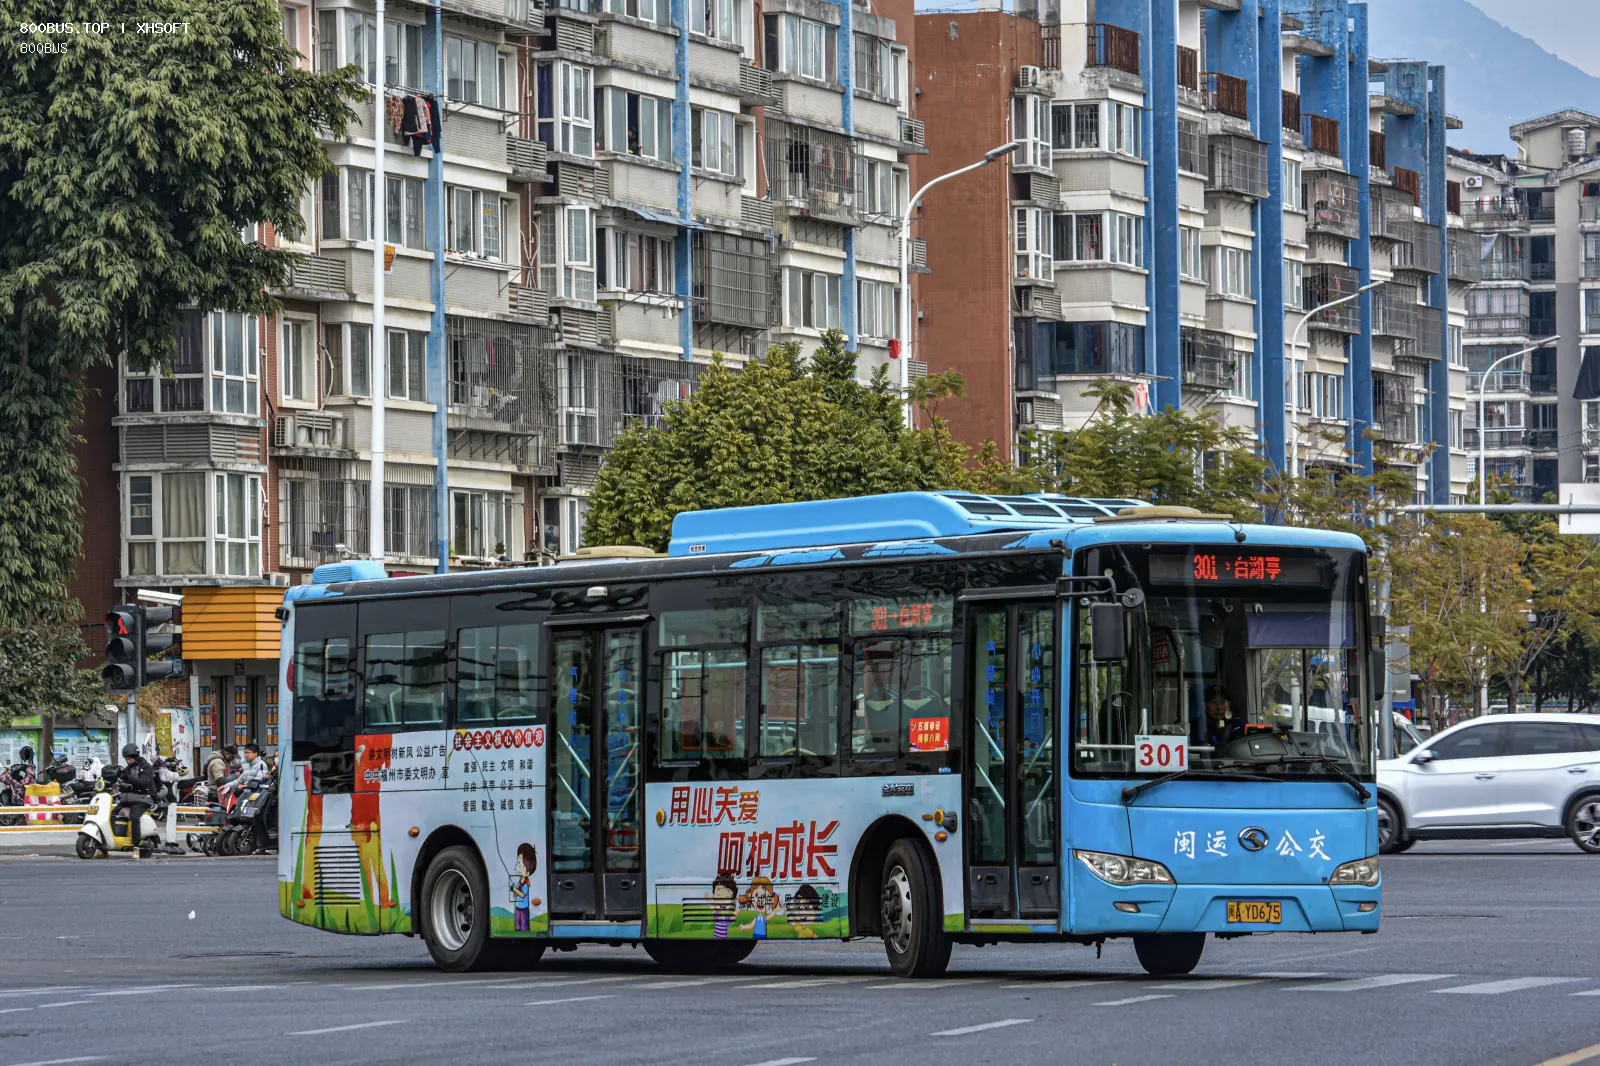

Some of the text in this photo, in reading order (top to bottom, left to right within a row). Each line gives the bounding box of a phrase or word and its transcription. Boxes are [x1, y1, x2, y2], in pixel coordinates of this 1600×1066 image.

[1193, 554, 1219, 580] 301
[454, 729, 544, 748] 社会主义核心价值观
[368, 744, 447, 761] 讲文明树新风 公益广告
[1139, 743, 1185, 767] 301
[364, 766, 437, 784] 中共福州市委文明办
[463, 758, 533, 773] 富强 民主 文明 和谐
[463, 780, 477, 792] 自由
[500, 779, 514, 791] 公正
[519, 777, 533, 790] 法治
[462, 797, 533, 813] 爱国 敬业 诚信 友善
[669, 785, 760, 825] 用心关爱
[717, 820, 840, 881] 呵护成长
[1174, 829, 1331, 861] 闽运 公交
